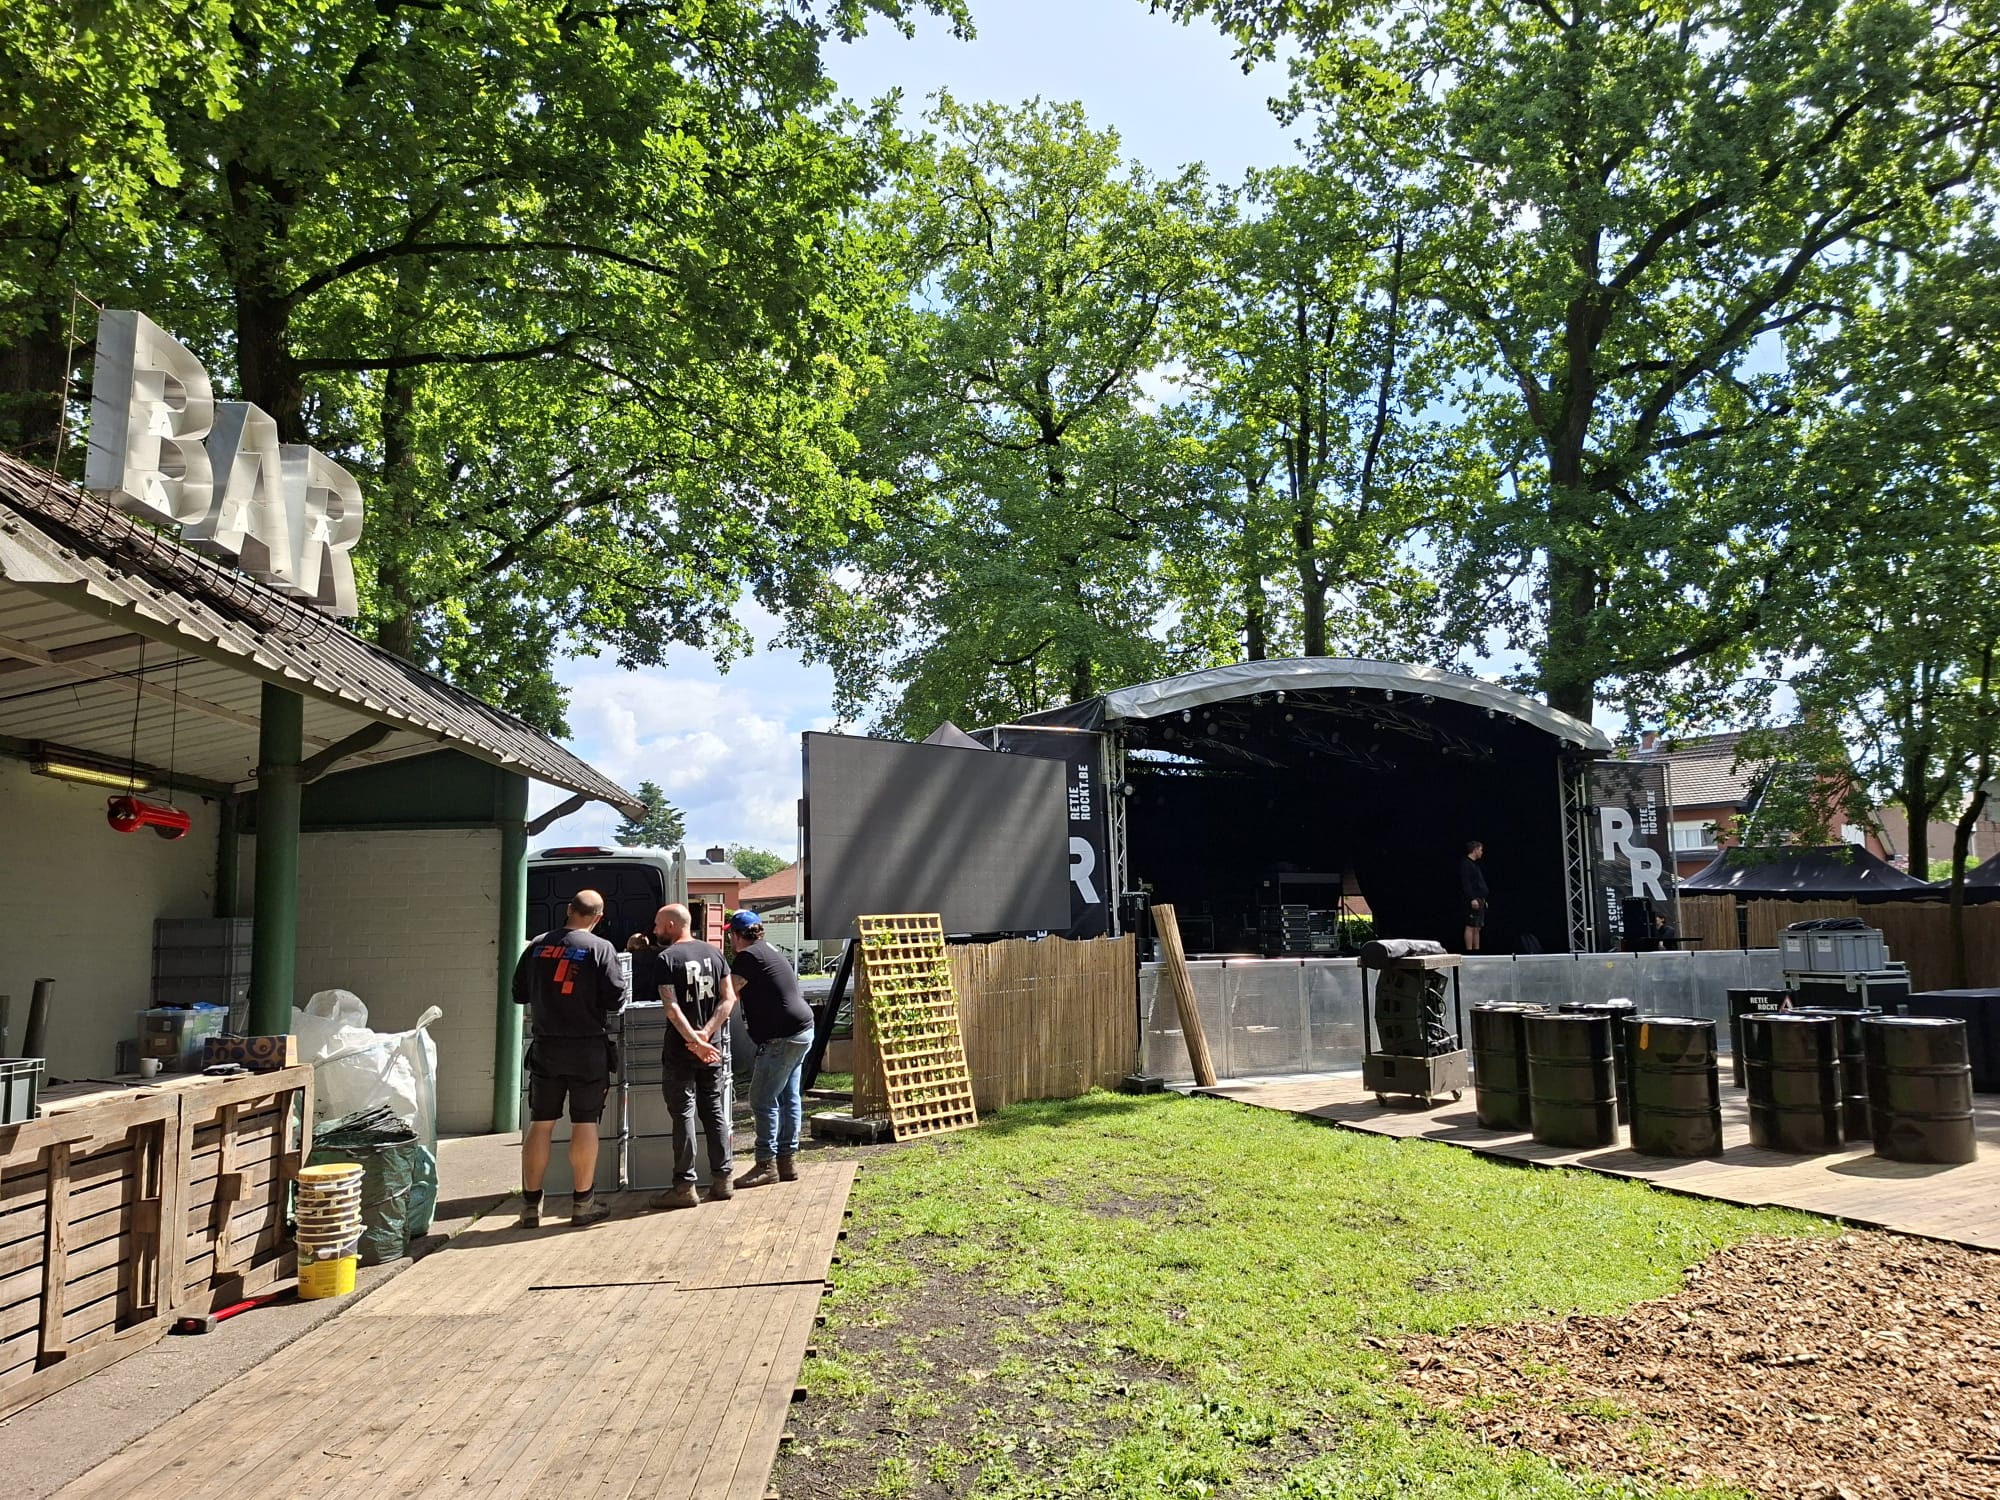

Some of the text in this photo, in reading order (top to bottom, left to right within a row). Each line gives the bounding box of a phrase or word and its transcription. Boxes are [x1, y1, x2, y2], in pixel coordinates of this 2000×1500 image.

[86, 310, 363, 617] BAR
[1069, 786, 1081, 820] RETIE
[1078, 764, 1091, 820] ROCKT.BE
[1640, 807, 1650, 835] RETIE
[1750, 996, 1769, 1004] RETIE
[1757, 1003, 1778, 1011] ROCKT
